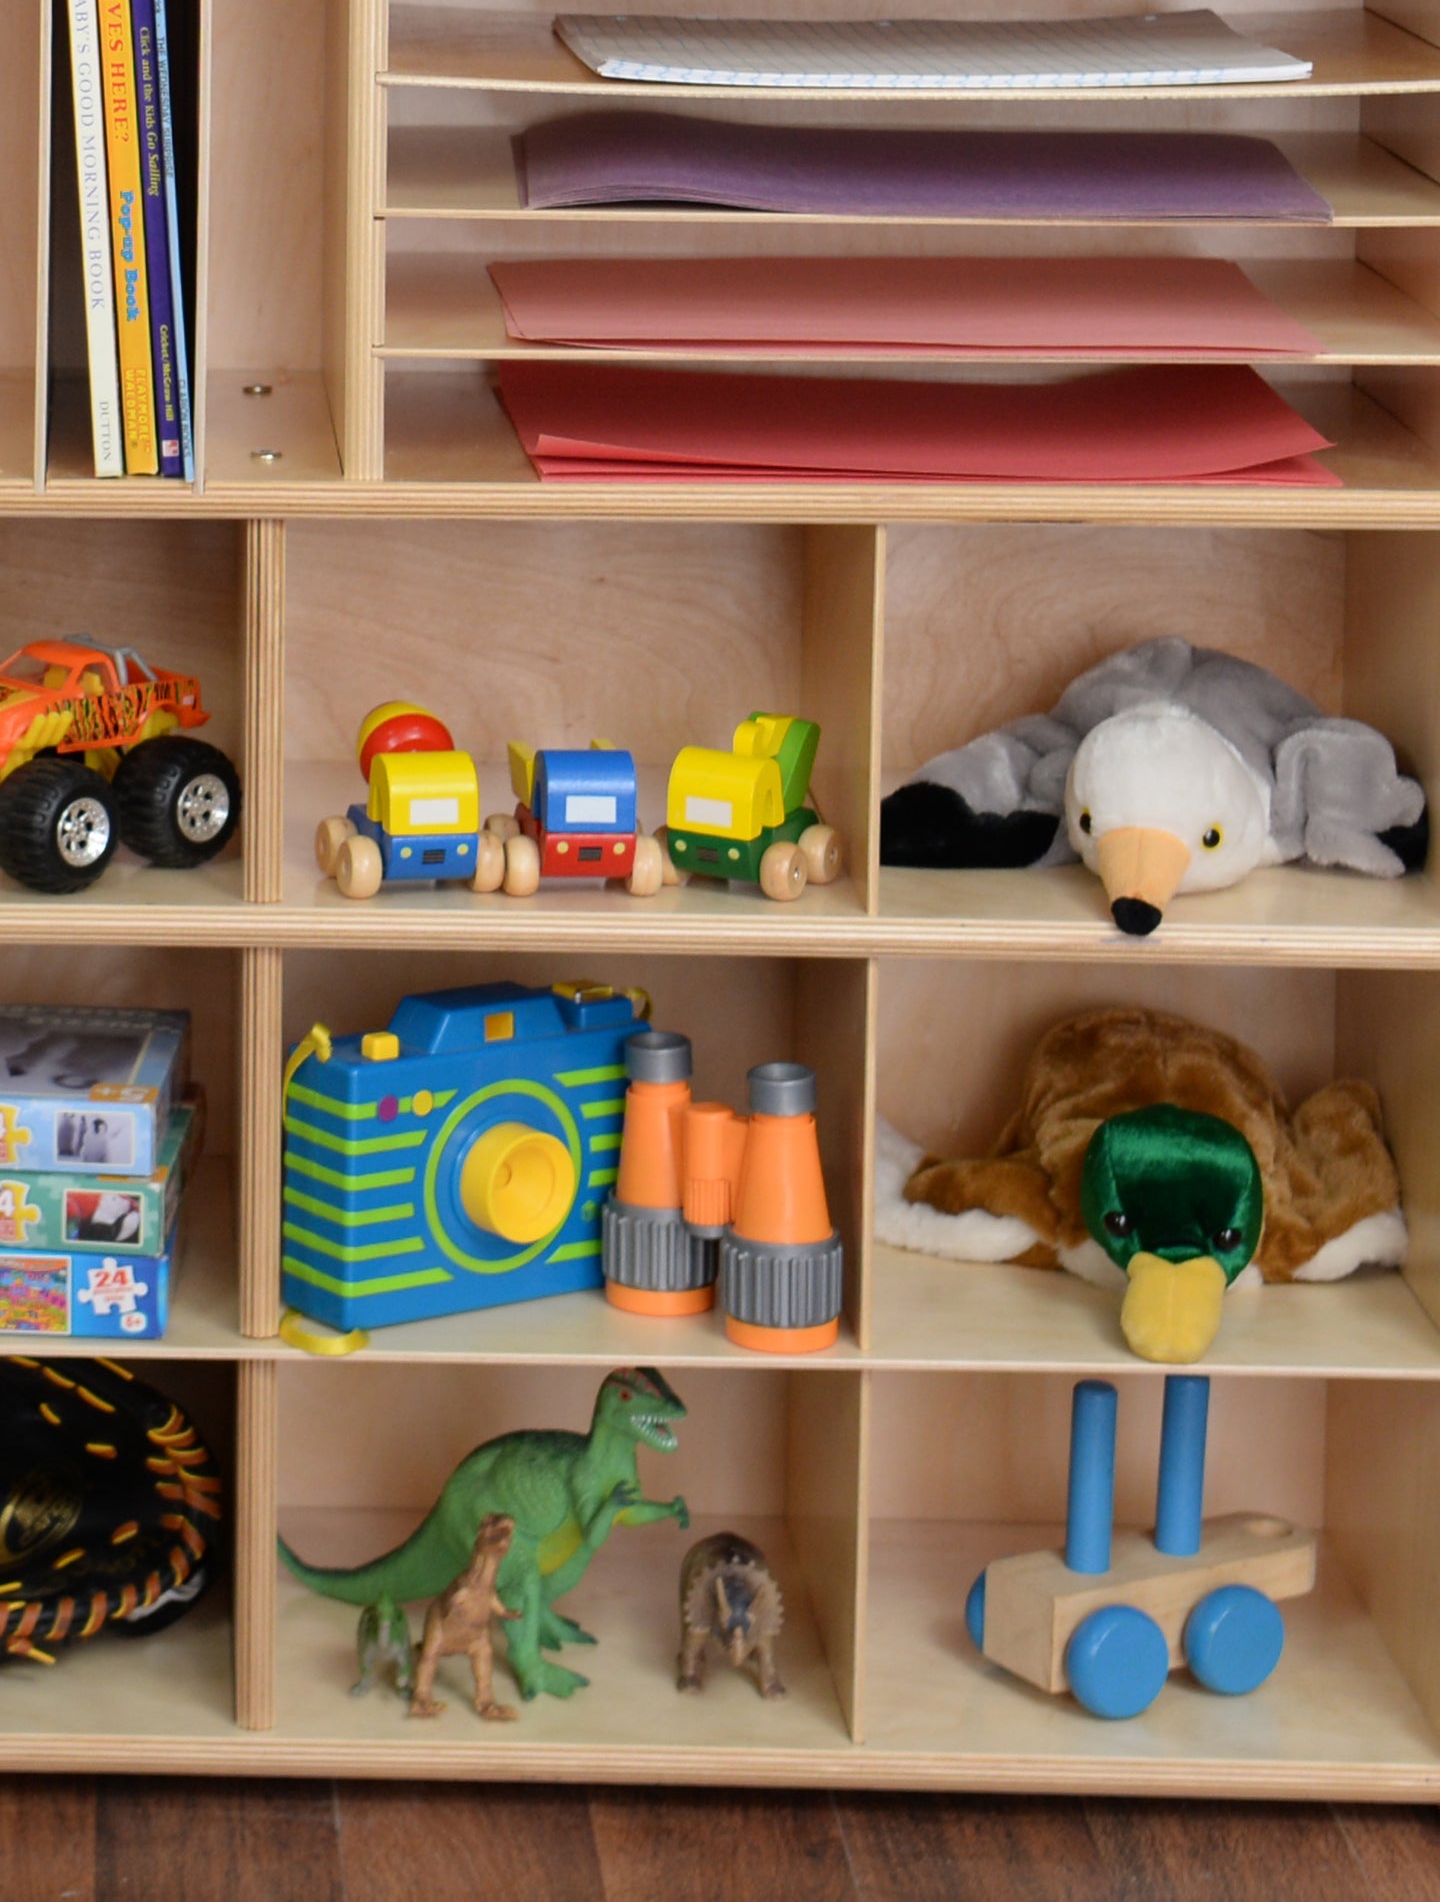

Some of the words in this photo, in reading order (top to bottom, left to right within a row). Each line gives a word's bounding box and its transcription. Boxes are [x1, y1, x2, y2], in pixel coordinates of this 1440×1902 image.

[140, 26, 151, 56] Click
[157, 36, 166, 57] THE
[78, 62, 95, 128] GOOD
[142, 59, 152, 81] and
[144, 83, 154, 102] the
[159, 60, 170, 124] WEDNESDAY
[110, 62, 129, 143] HERE?
[144, 105, 156, 129] Kids
[146, 131, 158, 151] Go
[163, 127, 174, 179] SURPRISE
[83, 135, 101, 241] MORNING
[147, 153, 161, 196] Sailing
[119, 190, 135, 263] Pop-up
[88, 249, 105, 311] BOOK
[125, 268, 140, 321] Book
[99, 400, 110, 462] DUTTON
[95, 1270, 129, 1288] 24
